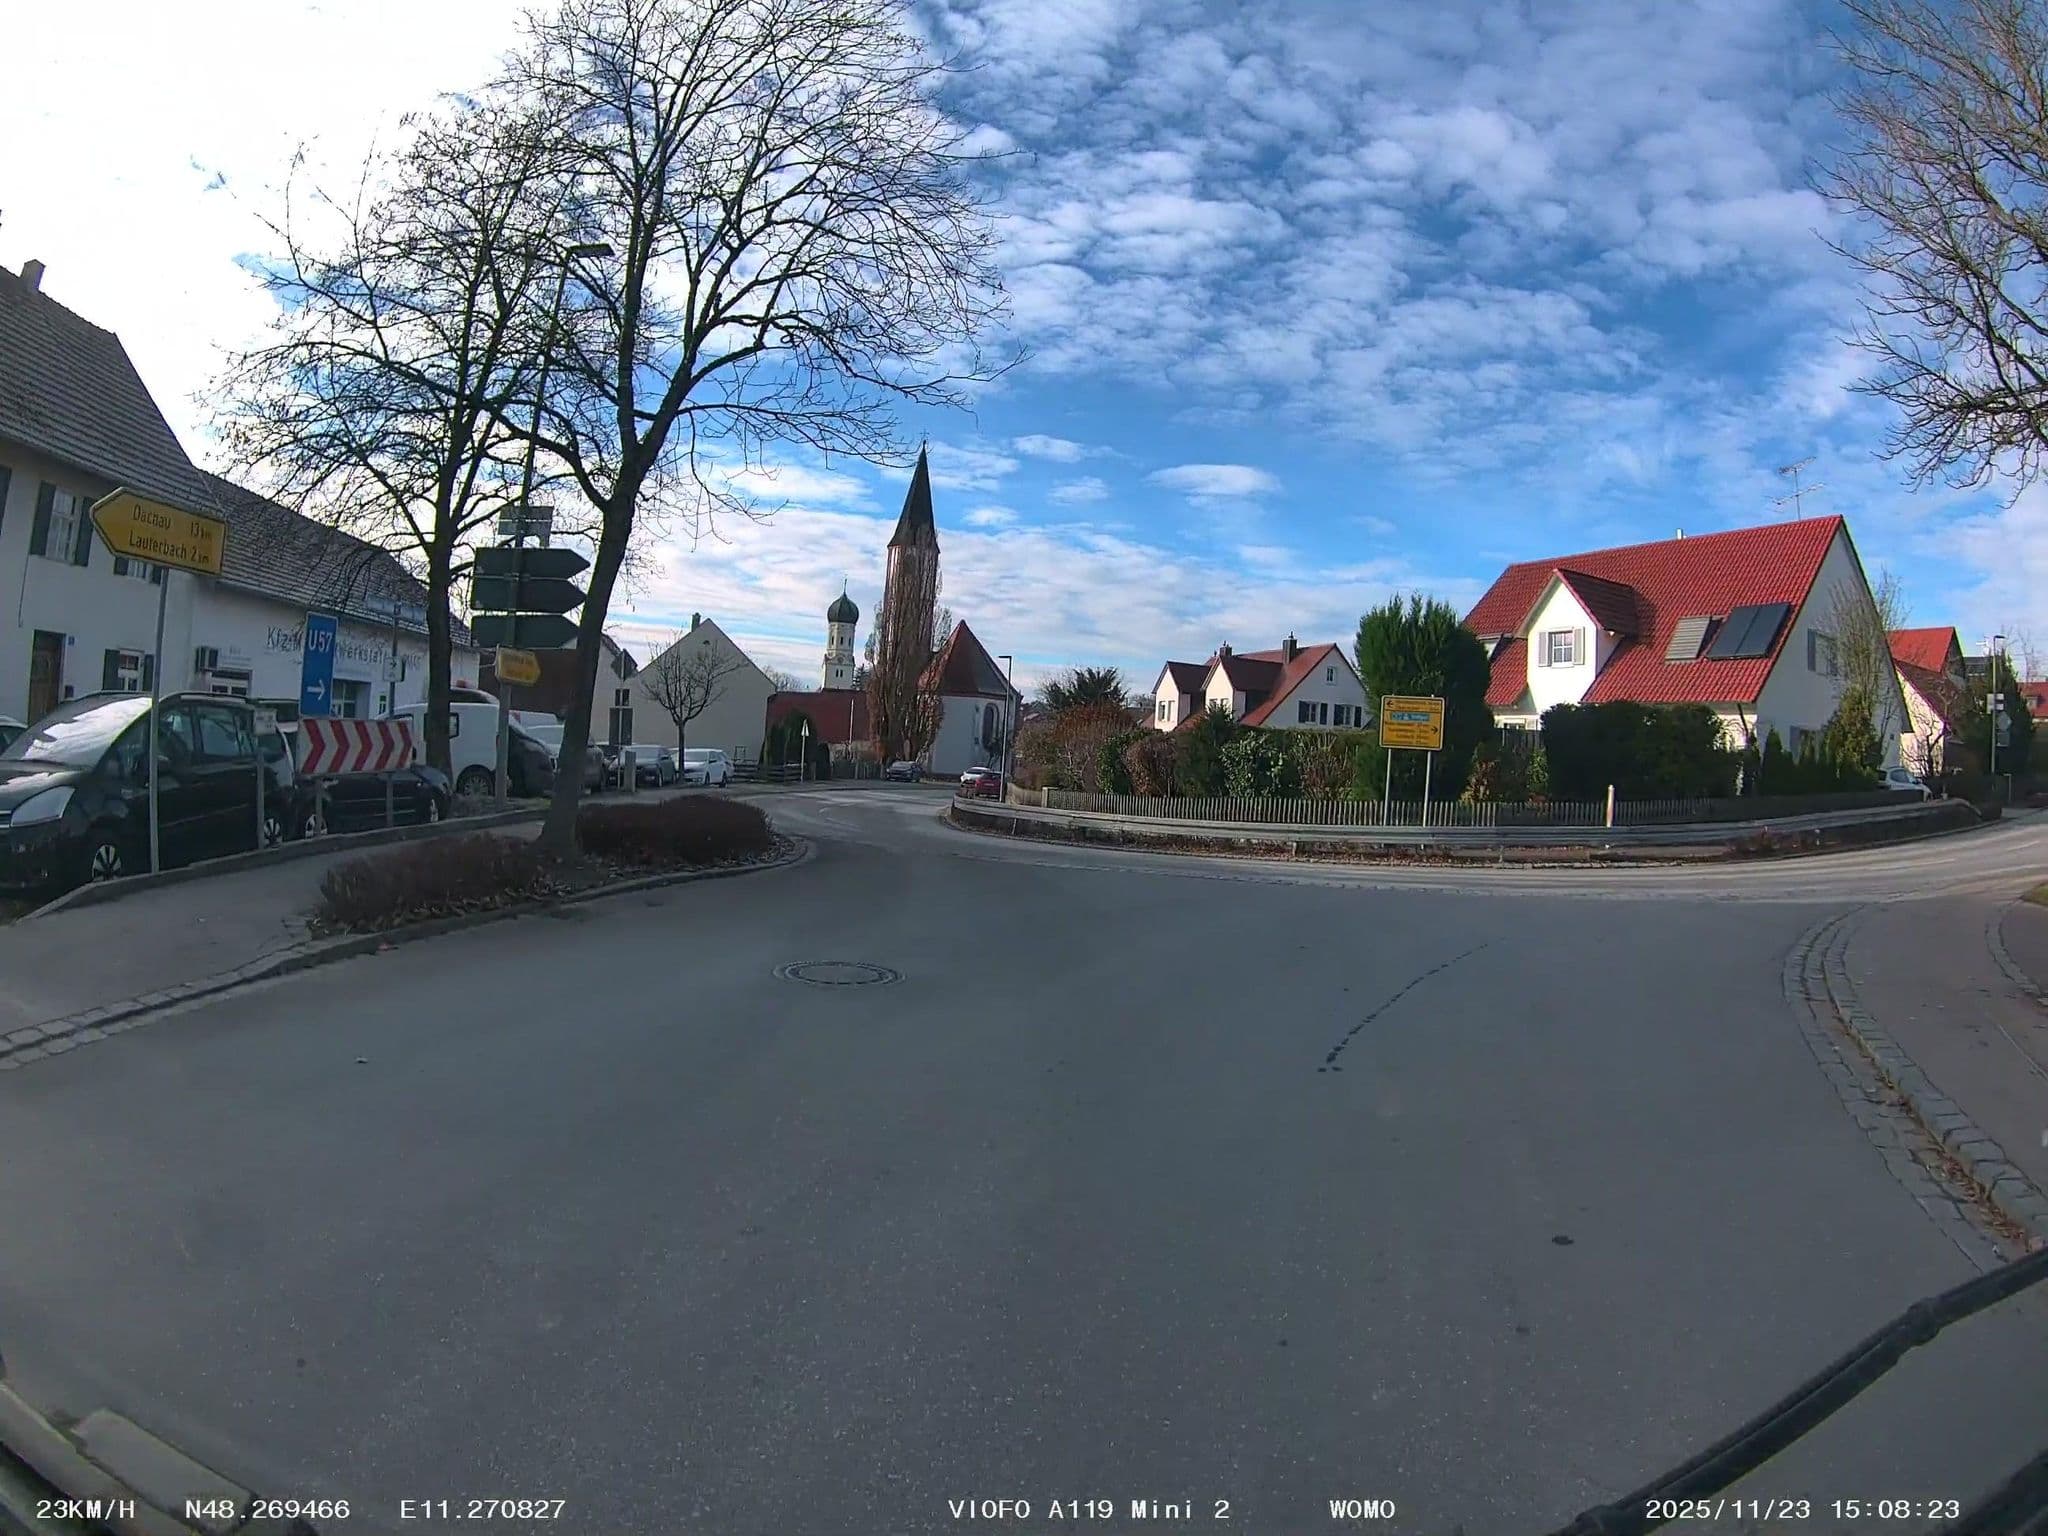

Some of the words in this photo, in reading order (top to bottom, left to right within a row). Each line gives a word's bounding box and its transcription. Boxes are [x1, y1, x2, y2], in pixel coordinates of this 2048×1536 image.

[132, 504, 172, 530] Dachau
[129, 530, 187, 559] Lauterbach
[190, 545, 197, 562] 2
[308, 629, 334, 653] U57
